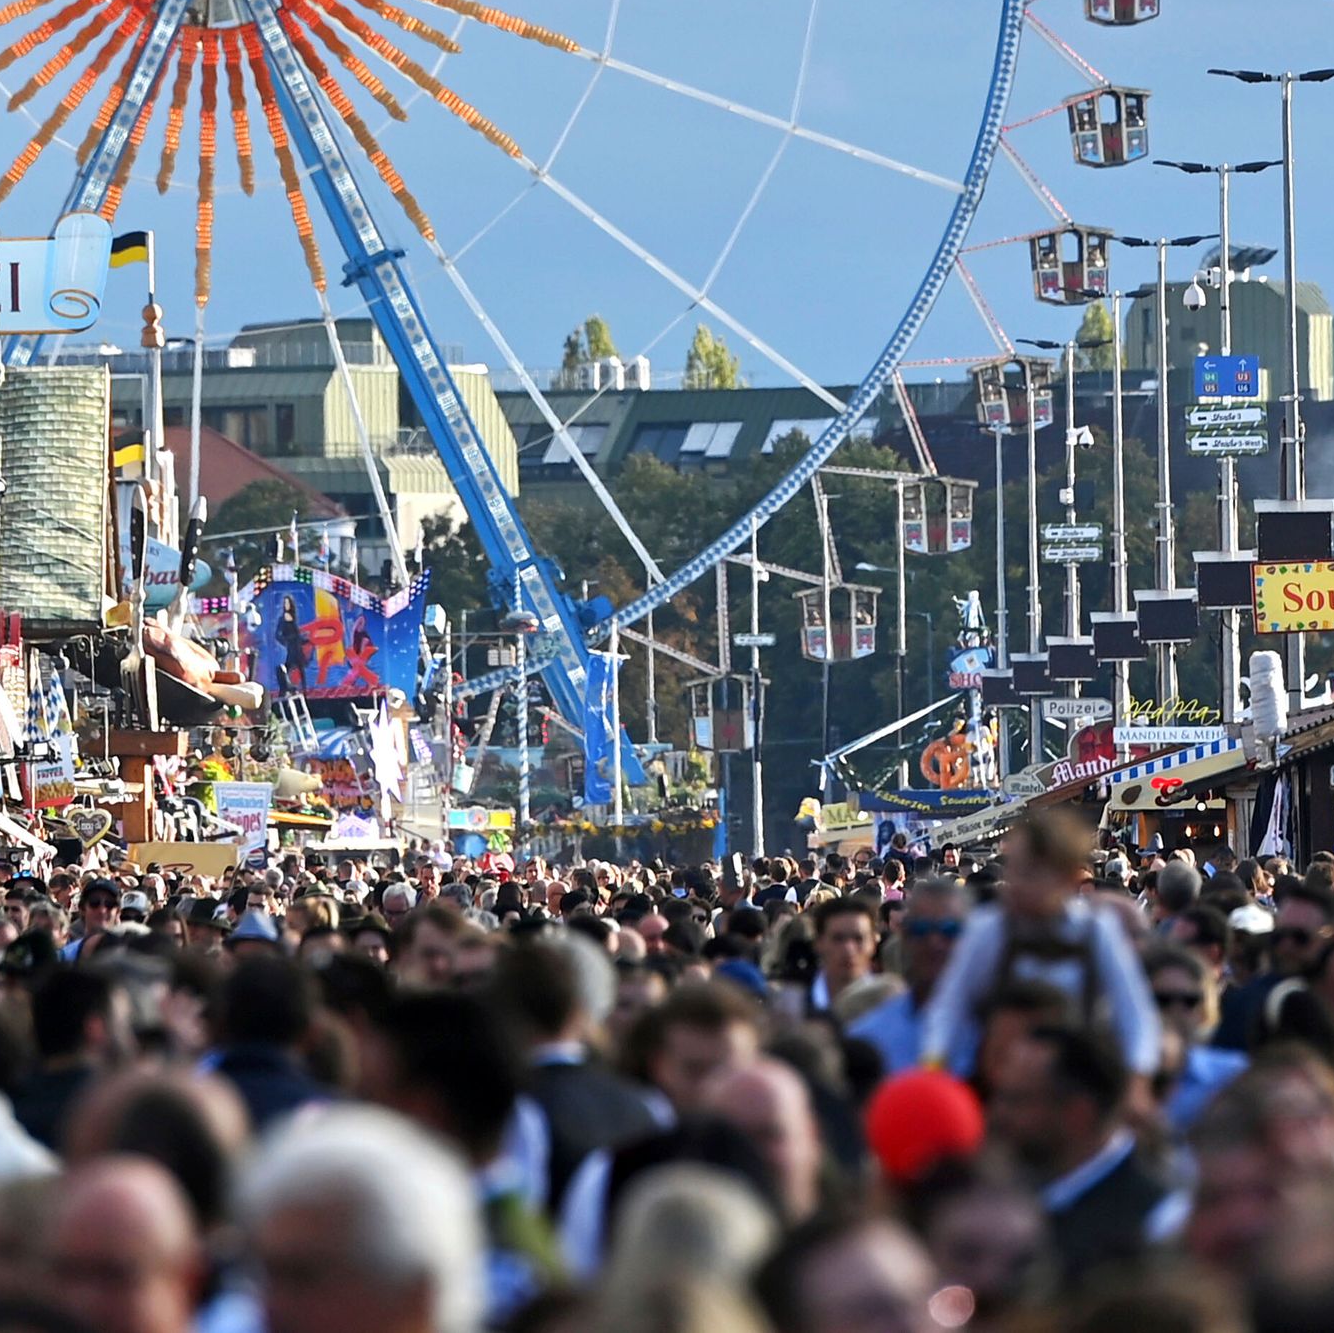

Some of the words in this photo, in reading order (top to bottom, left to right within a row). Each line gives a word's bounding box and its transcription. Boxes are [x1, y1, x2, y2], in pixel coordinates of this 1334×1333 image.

[1204, 373, 1216, 381] U4
[1237, 384, 1248, 392] U6
[1049, 701, 1097, 714] Polizei
[1119, 730, 1178, 741] MANDELN
